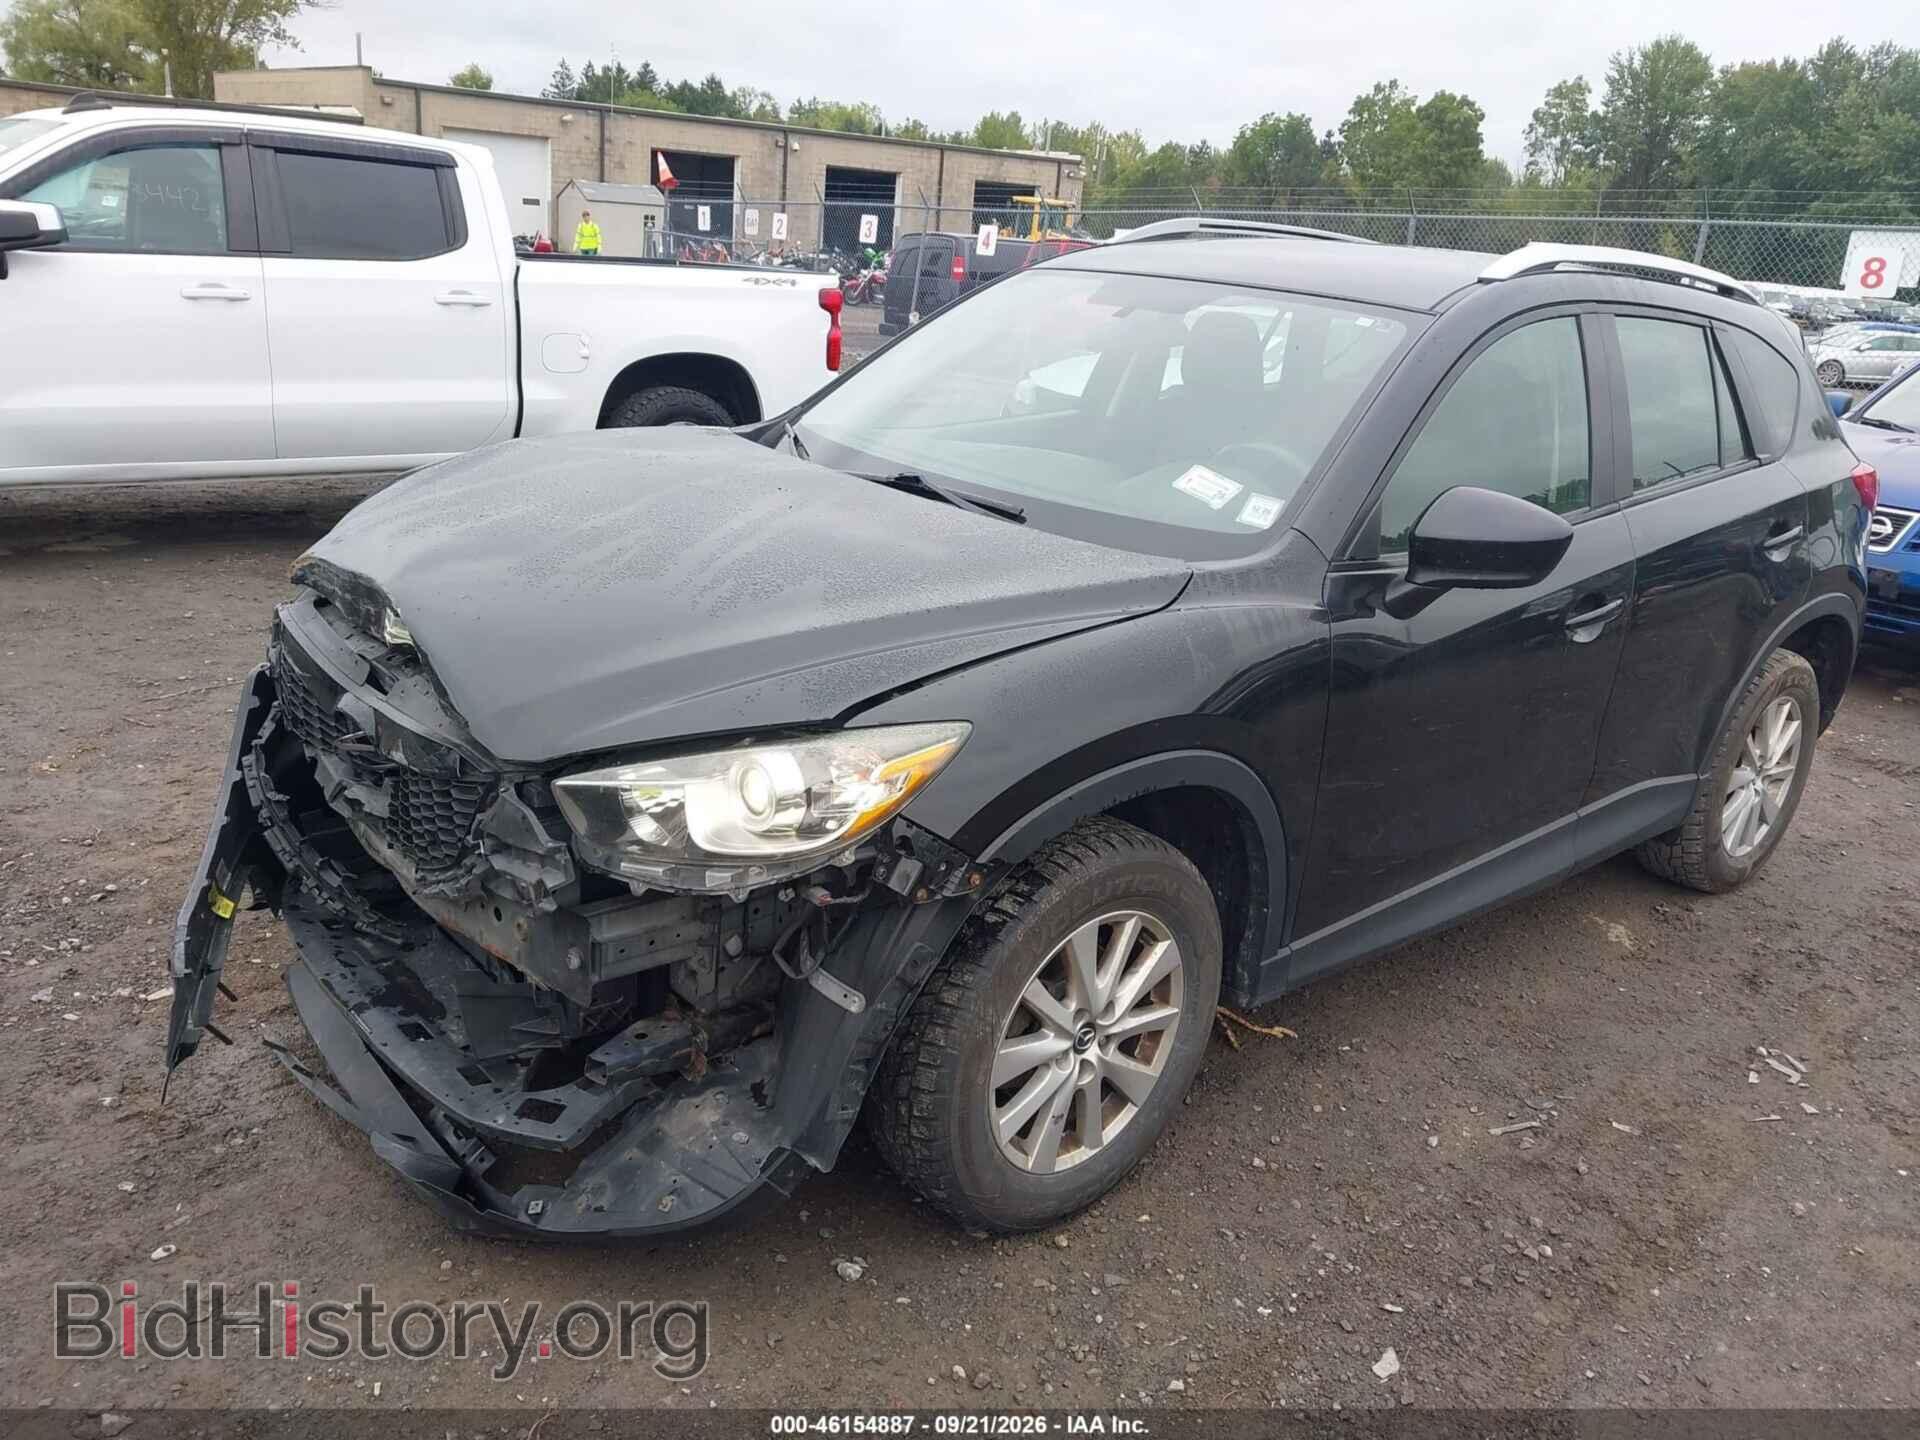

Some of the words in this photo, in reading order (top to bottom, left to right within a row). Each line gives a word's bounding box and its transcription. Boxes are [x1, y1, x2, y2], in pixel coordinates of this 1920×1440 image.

[775, 218, 784, 235] 2
[864, 220, 873, 239] 3
[982, 231, 991, 250] 4
[1860, 256, 1887, 289] 8
